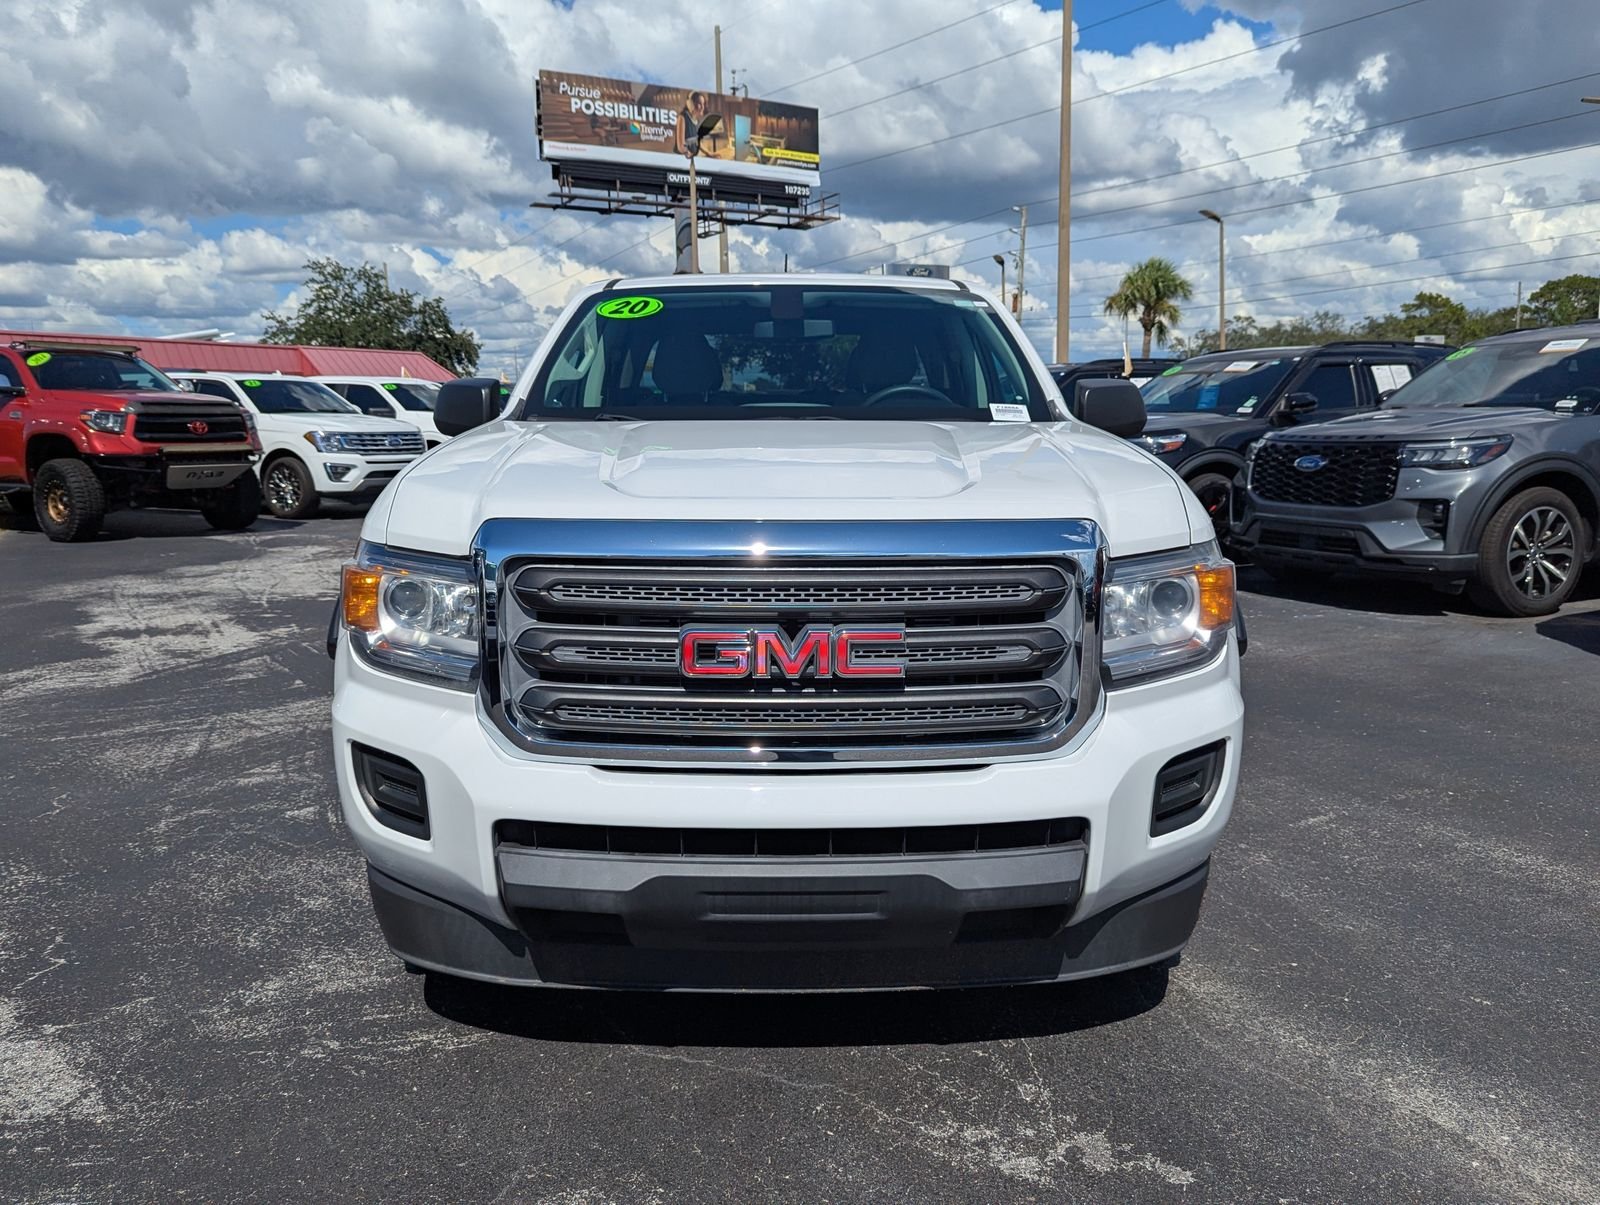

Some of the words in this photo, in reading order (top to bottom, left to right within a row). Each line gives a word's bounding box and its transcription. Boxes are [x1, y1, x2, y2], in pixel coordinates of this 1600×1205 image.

[559, 82, 601, 99] Pursue
[570, 97, 678, 125] POSSIBILITIES
[607, 300, 651, 315] 20
[679, 623, 906, 679] GMC
